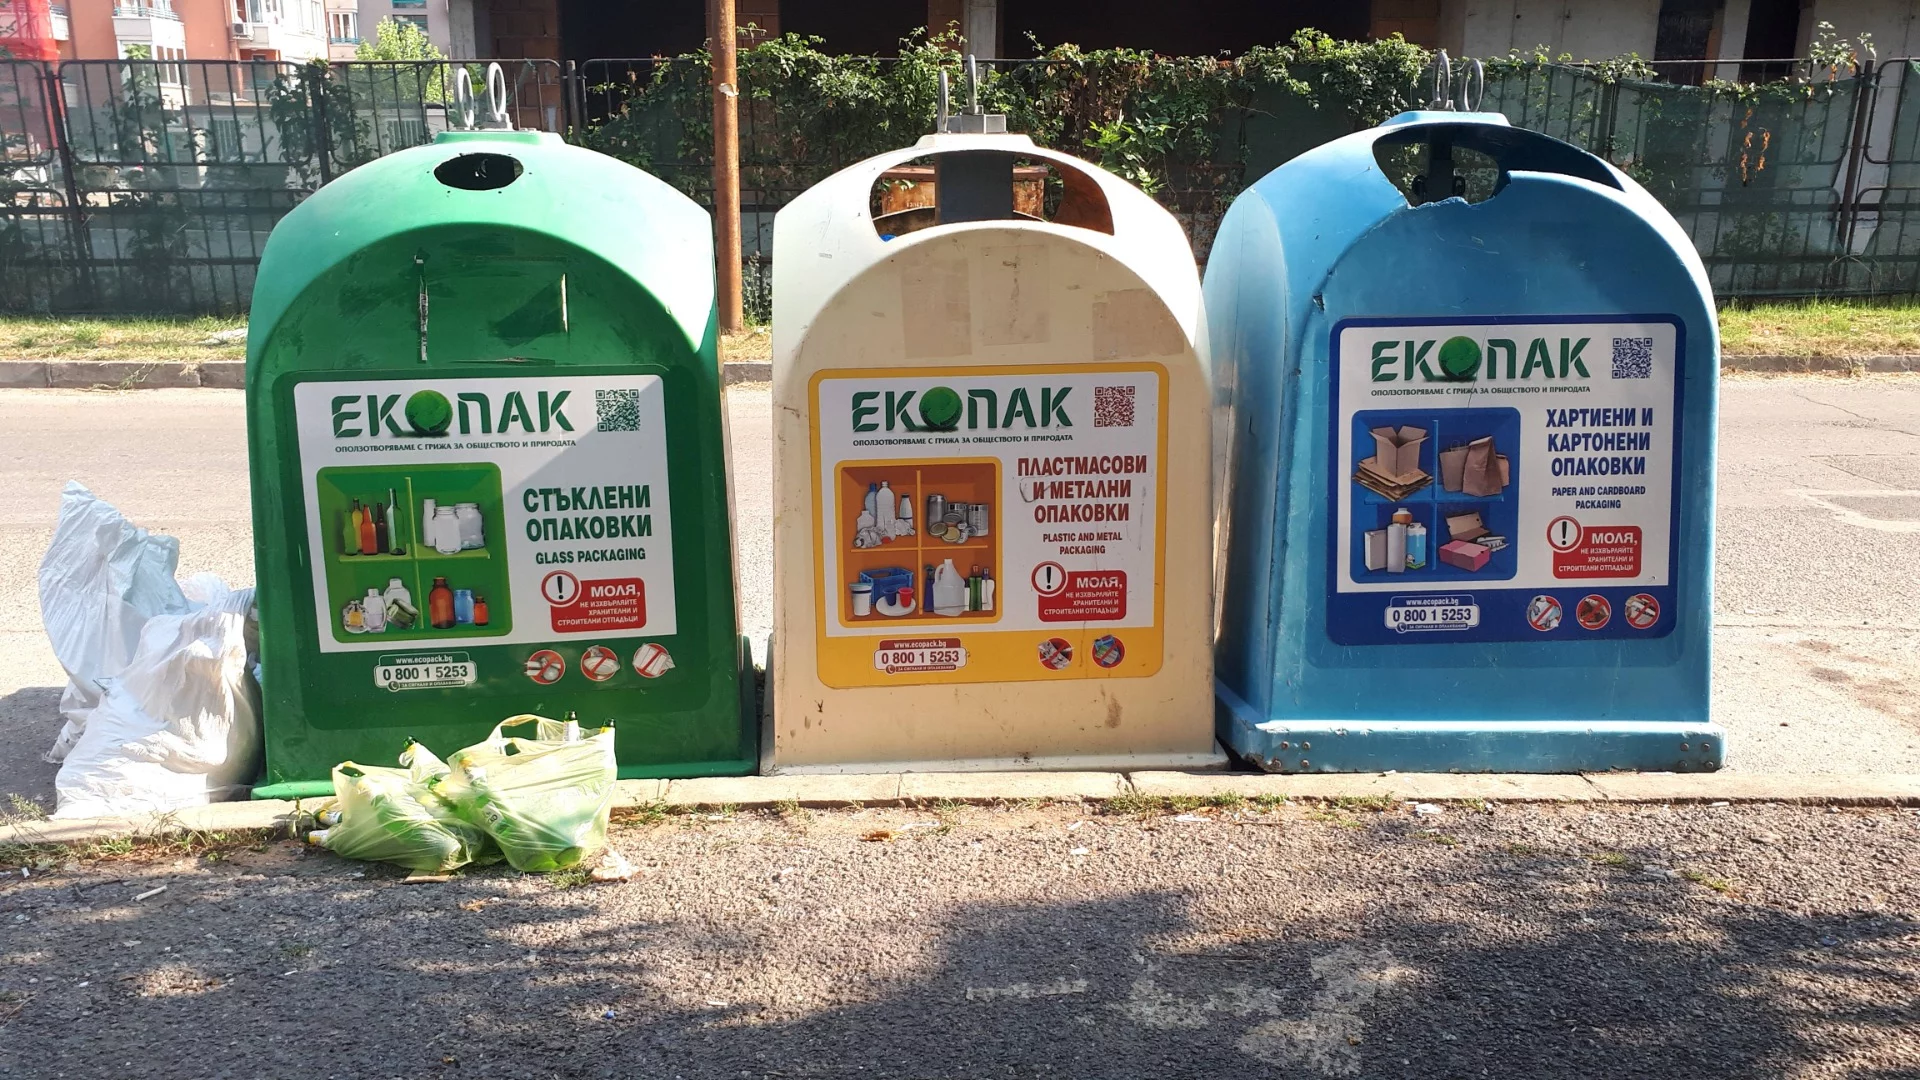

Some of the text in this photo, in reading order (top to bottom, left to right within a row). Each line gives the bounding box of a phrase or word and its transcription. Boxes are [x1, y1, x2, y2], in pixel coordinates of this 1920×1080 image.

[1371, 335, 1591, 382] ЕКОПАК
[1371, 388, 1444, 397] ОПОЛЗОТВОРЯВАМЕ
[1491, 387, 1540, 395] ОБЩЕСТВОТО
[332, 390, 575, 438] ЕКОПАК
[852, 386, 1073, 432] ЕКОПАК
[1546, 408, 1653, 427] ХАРТИЕНИ И
[335, 444, 415, 453] ОПОЛЗОТВОРЯВАМЕ
[466, 441, 520, 450] ОБЩЕСТВОТО
[530, 440, 576, 448] ПРИРОДАТА
[853, 438, 926, 447] ОПОЛЗОТВОРЯВАМЕ
[972, 436, 1022, 445] ОБЩЕСТВОТО
[1548, 432, 1650, 452] КАРТОНЕНИ
[1017, 455, 1147, 476] ПЛАСТМАСОВИ
[1551, 457, 1645, 476] ОПАКОВКИ
[1033, 479, 1131, 499] И МЕТАЛНИ
[1552, 486, 1646, 496] PAPER AND CARDBOARD
[523, 485, 651, 513] СТЪКЛЕНИ
[1575, 500, 1621, 509] PACKAGING
[1034, 503, 1129, 523] ОПАКОВКИ
[526, 514, 652, 542] ОПАКОВКИ
[1043, 532, 1122, 542] PLASTIC AND METAL
[1591, 533, 1638, 545] МОЛЯ,
[536, 548, 646, 564] GLASS PACKAGING
[1059, 545, 1105, 555] PACKAGING
[1600, 564, 1633, 572] ОТПАДЪЦИ
[1077, 577, 1123, 589] МОЛЯ,
[591, 584, 641, 598] МОЛЯ,
[1075, 590, 1119, 598] ИЗХВЪРЛЯЙТЕ
[590, 599, 637, 607] ИЗХВЪРЛЯЙТЕ
[1406, 598, 1459, 606] www.ecopack.bg
[588, 608, 631, 616] ХРАНИТЕЛНИ
[1393, 608, 1471, 622] 0 800 1 5253
[558, 618, 601, 626] СТРОИТЕЛНИ
[894, 640, 946, 649] www.ecopack.bg
[396, 655, 453, 664] www.ecopack.bg
[881, 650, 959, 664] 0 800 1 5253
[383, 665, 468, 681] 0 800 1 5253
